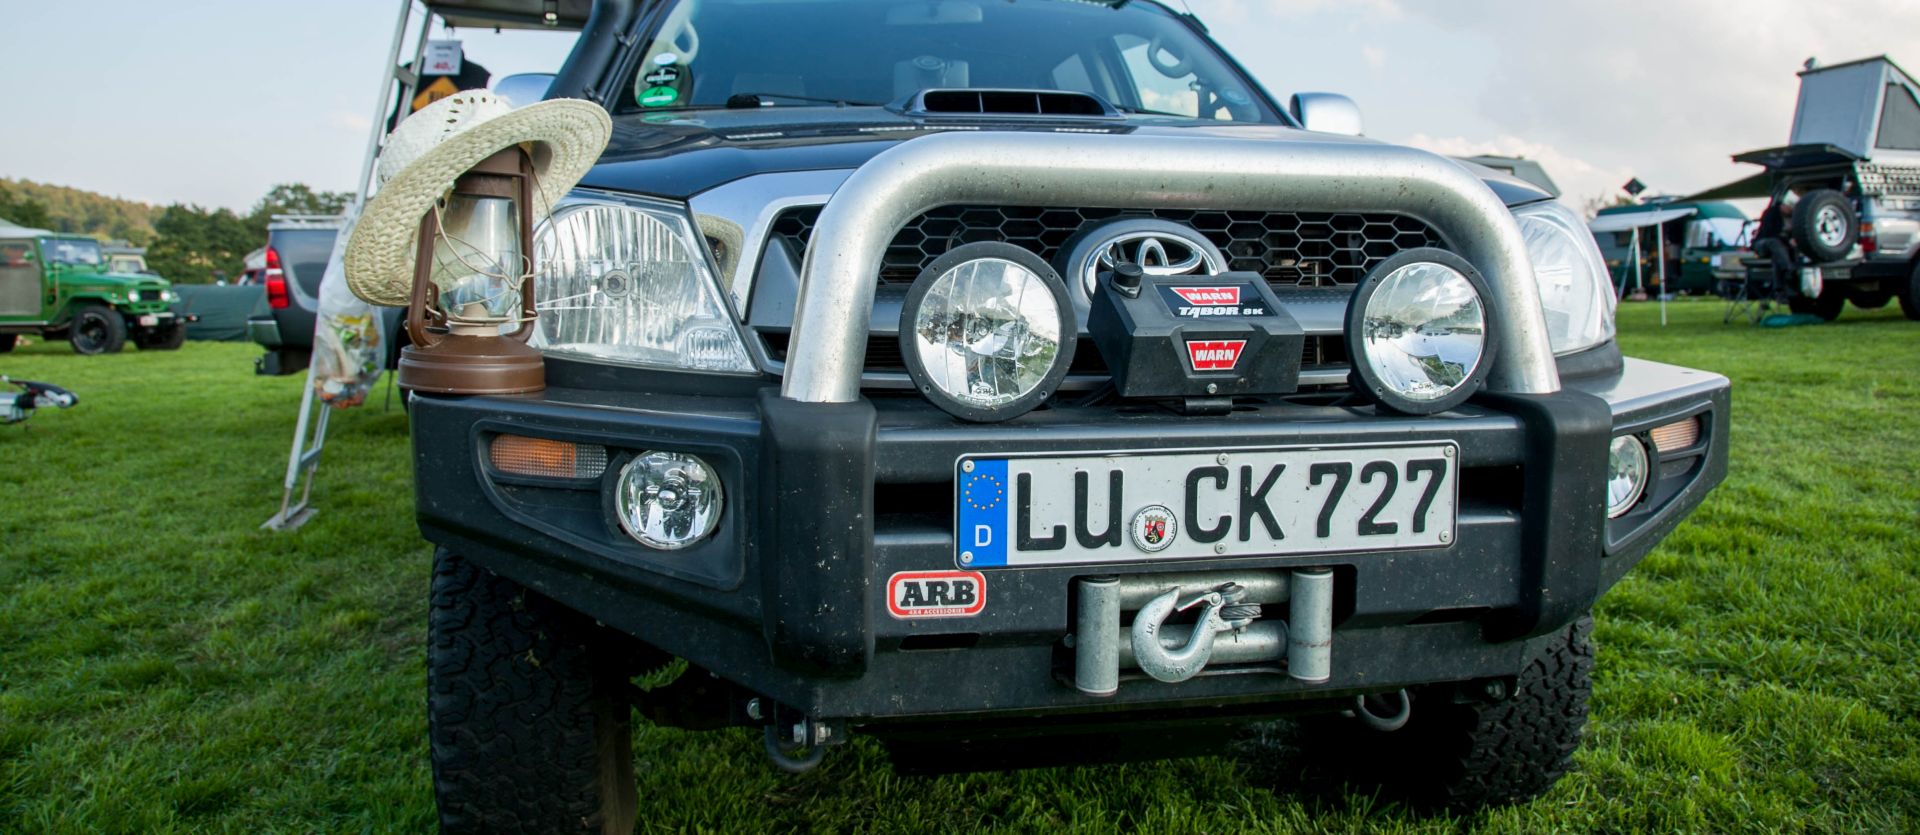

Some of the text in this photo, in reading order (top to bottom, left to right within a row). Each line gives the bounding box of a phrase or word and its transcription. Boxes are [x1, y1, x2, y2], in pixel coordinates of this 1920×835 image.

[1186, 292, 1235, 300] WARN
[1178, 306, 1239, 318] TABOR
[1195, 349, 1235, 361] WARN
[1016, 458, 1447, 551] LU CK 727
[974, 524, 992, 547] D
[900, 580, 976, 606] ARB
